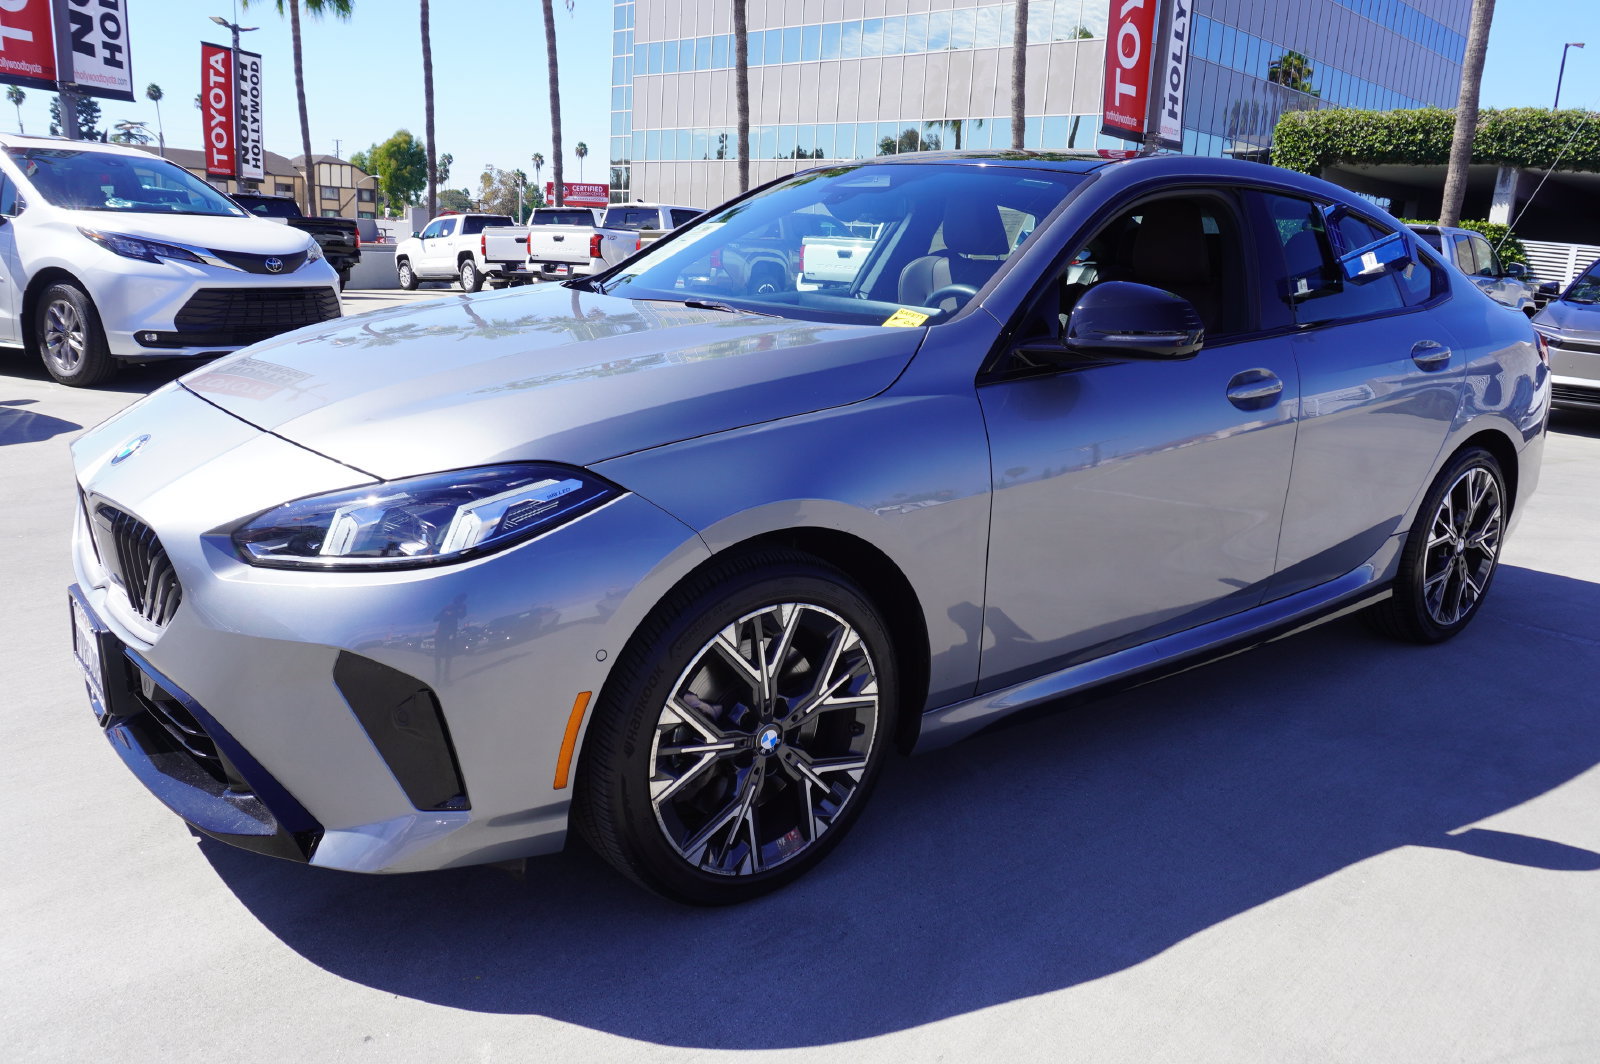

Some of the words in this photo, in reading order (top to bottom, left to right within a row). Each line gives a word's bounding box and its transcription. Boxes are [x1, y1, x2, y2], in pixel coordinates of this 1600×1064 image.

[209, 52, 229, 166] TOYOTA
[250, 61, 261, 169] HOLLYWOOD
[572, 185, 604, 193] CERTIFIED
